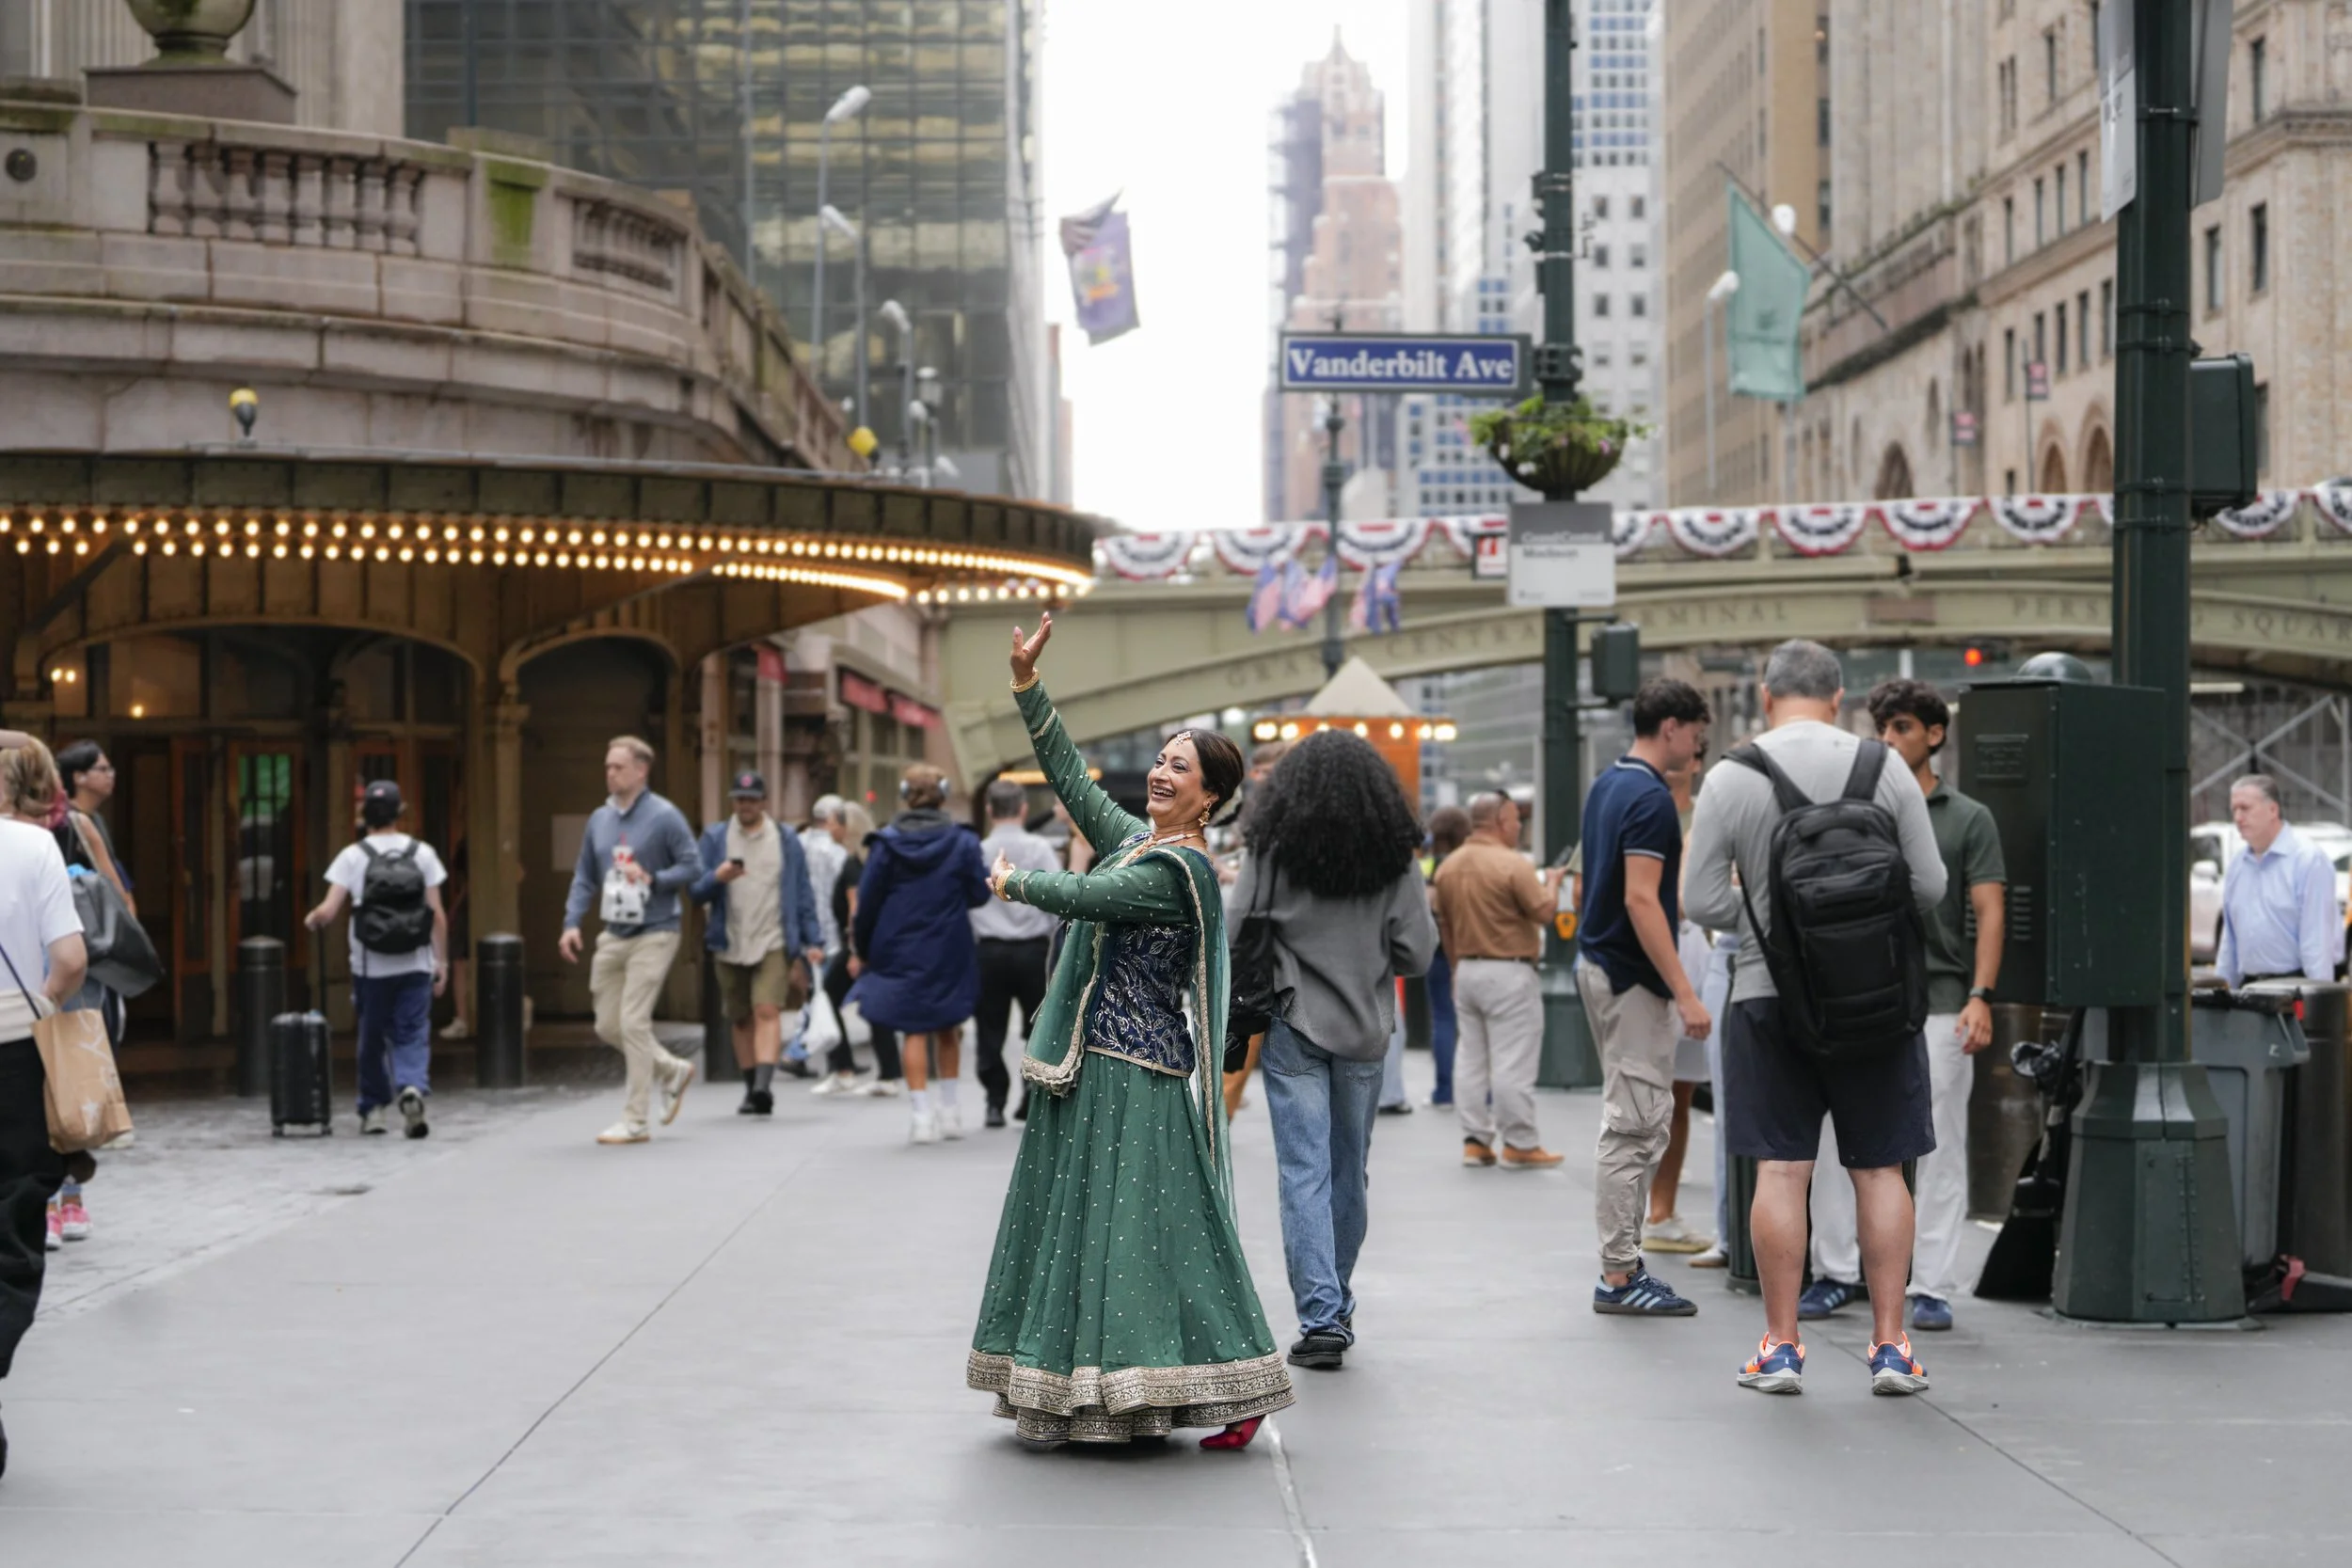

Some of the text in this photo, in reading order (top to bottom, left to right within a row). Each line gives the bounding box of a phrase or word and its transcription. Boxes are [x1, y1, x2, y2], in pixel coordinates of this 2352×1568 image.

[1289, 348, 1514, 379] Vanderbilt Ave
[1385, 622, 1536, 659] CENTRA
[2232, 609, 2352, 641] SQUAR
